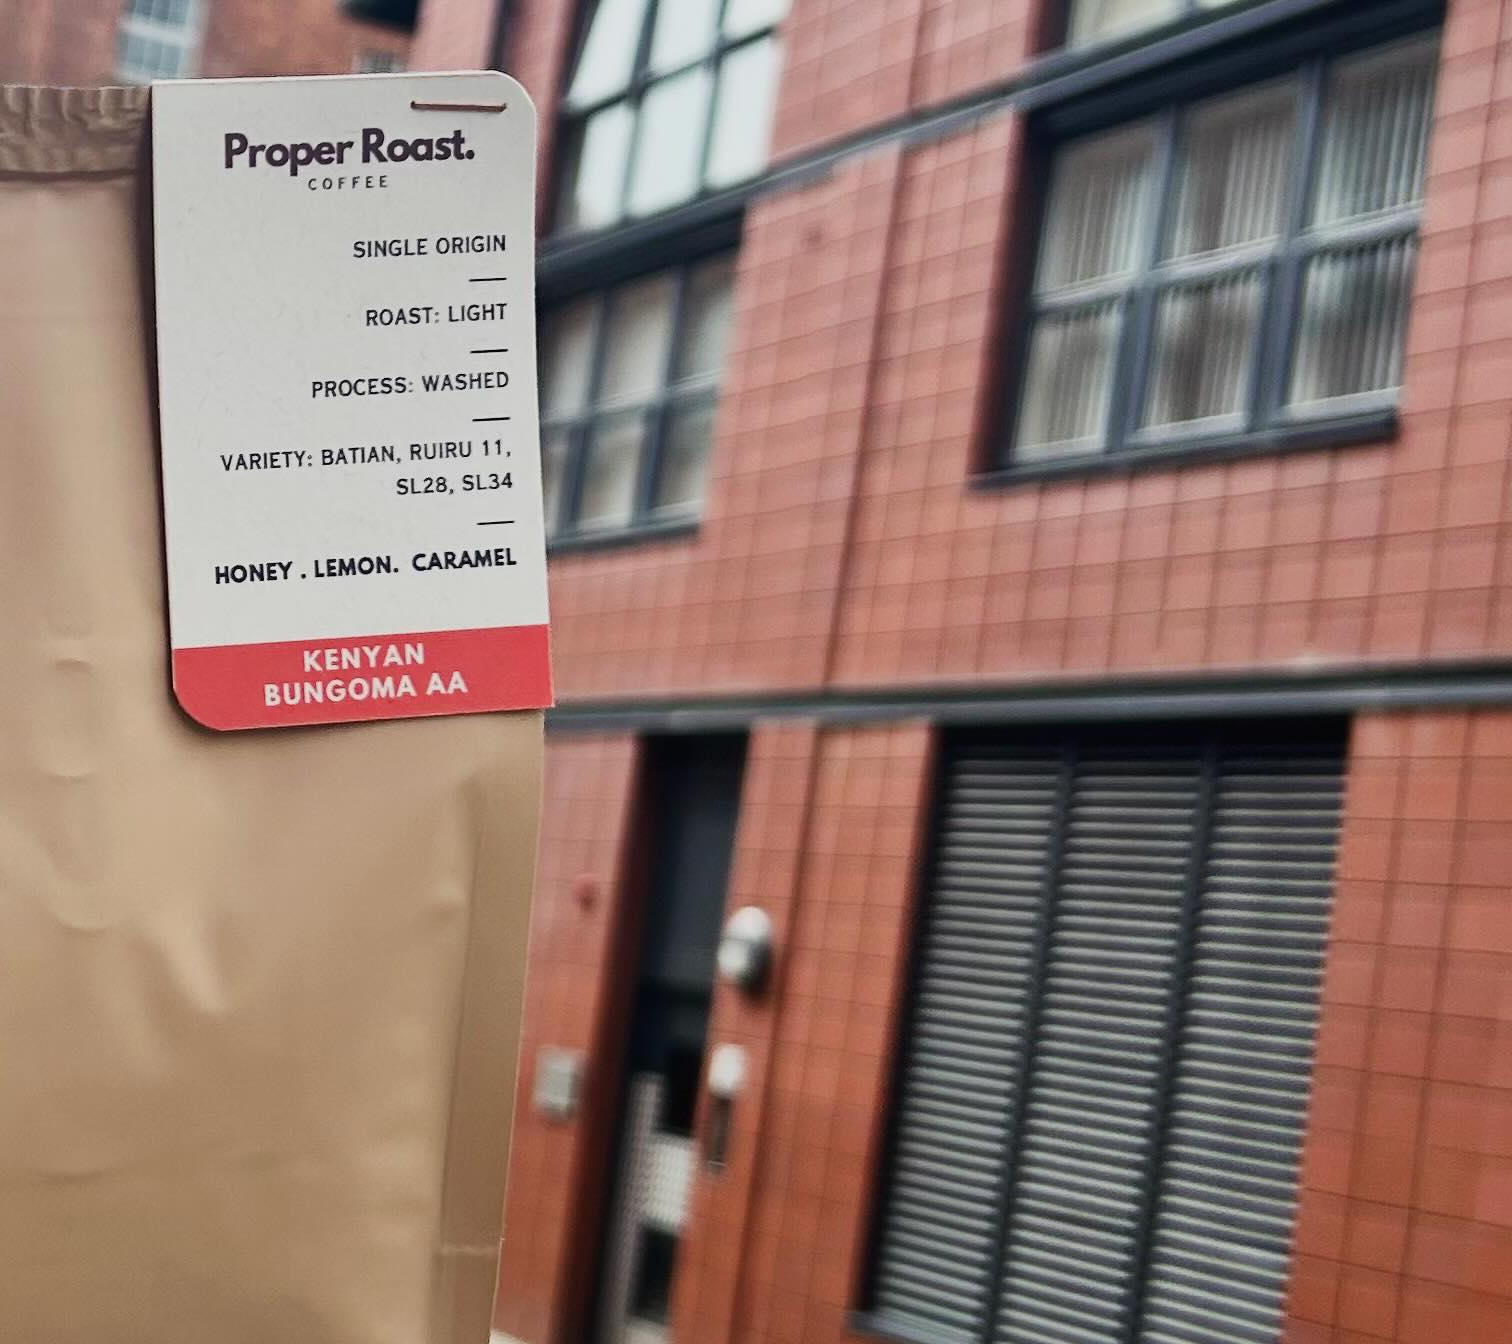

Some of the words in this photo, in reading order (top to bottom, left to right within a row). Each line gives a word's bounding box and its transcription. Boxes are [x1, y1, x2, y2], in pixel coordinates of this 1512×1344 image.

[224, 132, 355, 177] Proper
[361, 127, 476, 164] Roast.
[307, 174, 389, 192] COFFEE
[353, 237, 428, 259] SINGLE
[435, 234, 507, 255] ORIGIN
[365, 305, 440, 327] ROAST:
[448, 302, 508, 323] LIGHT
[311, 376, 414, 399] PROCESS:
[421, 371, 509, 393] WASHED
[219, 450, 313, 472] VARIETY:
[320, 444, 402, 467] BATIAN,
[409, 440, 472, 461] RUIRU
[482, 438, 512, 458] 11,
[395, 476, 455, 496] SL28,
[462, 472, 513, 492] SL34
[214, 560, 293, 585] HONEY
[313, 554, 399, 579] LEMON.
[411, 547, 517, 573] CARAMEL
[302, 642, 425, 673] KENYAN
[263, 673, 417, 707] BUNGOMA
[425, 671, 468, 696] AA
